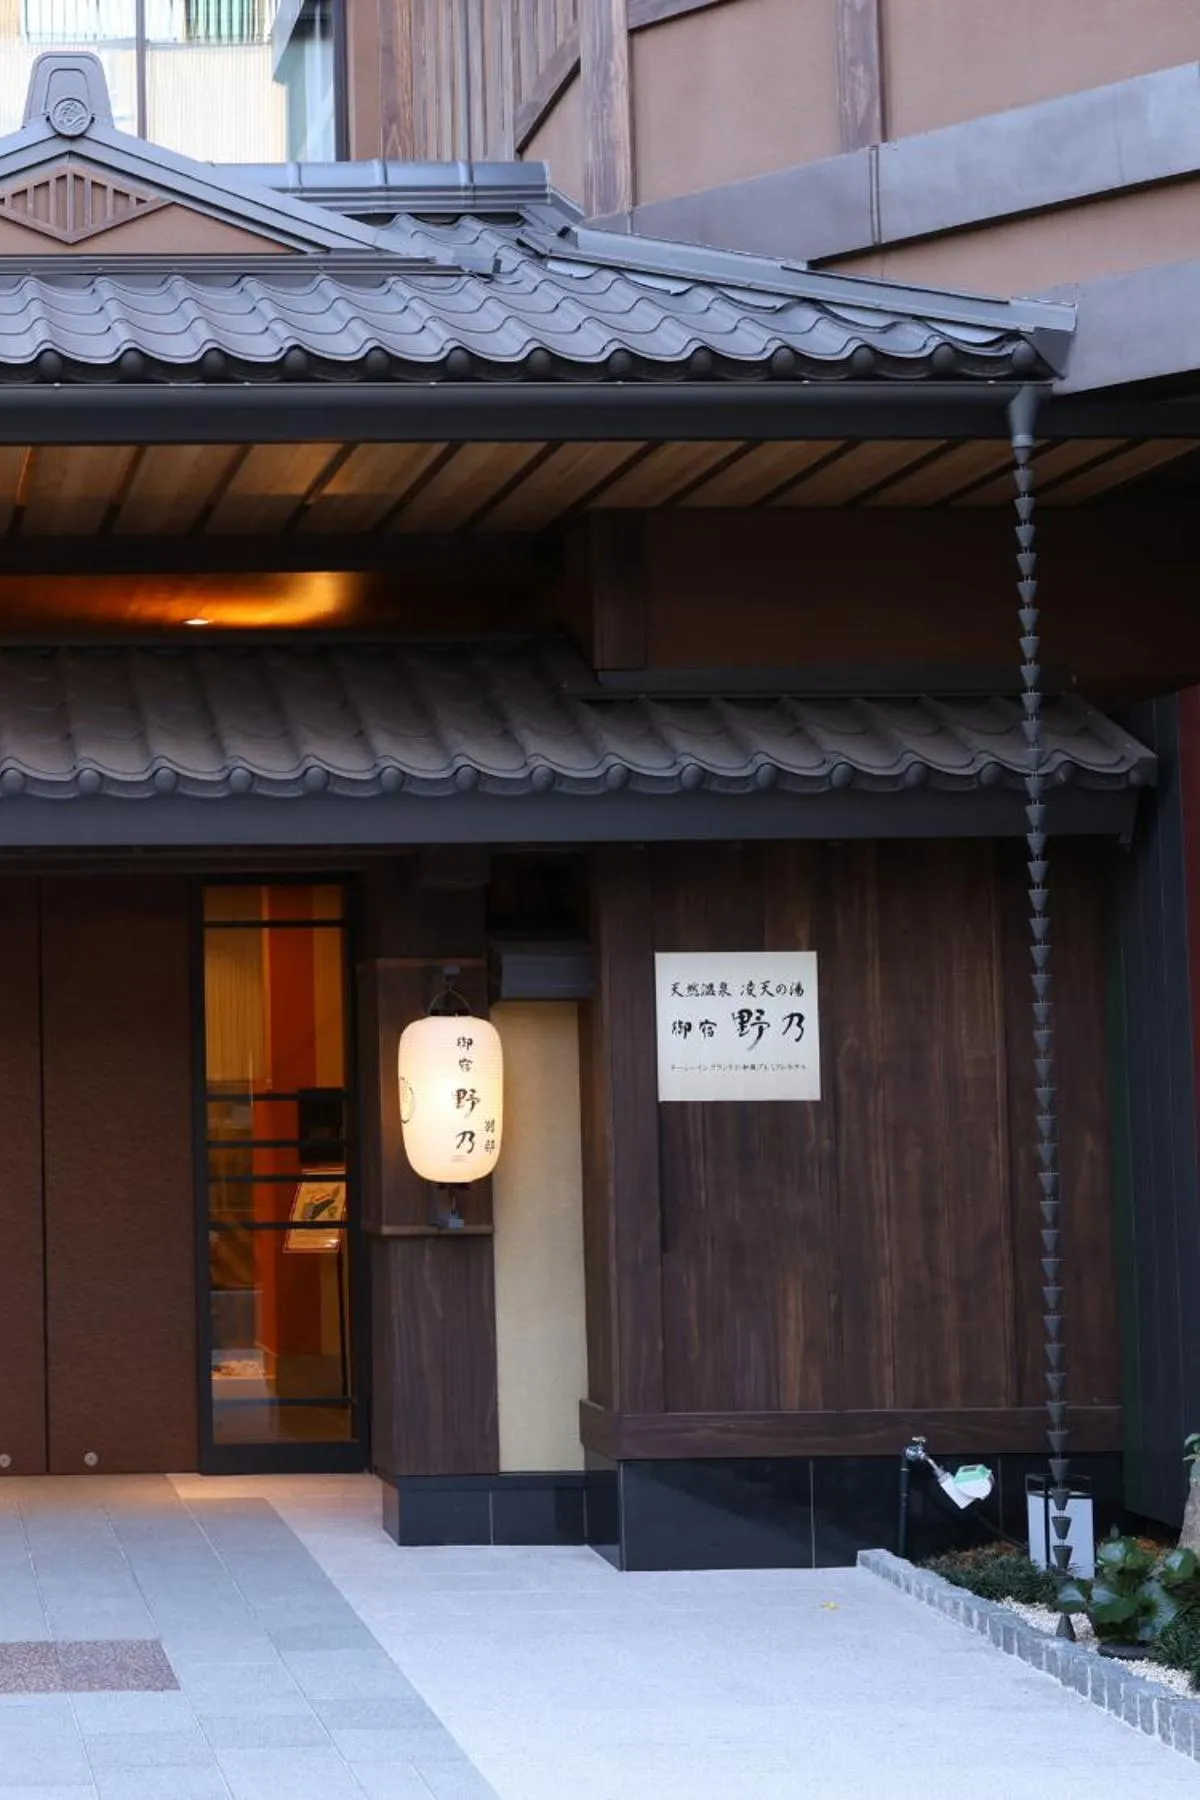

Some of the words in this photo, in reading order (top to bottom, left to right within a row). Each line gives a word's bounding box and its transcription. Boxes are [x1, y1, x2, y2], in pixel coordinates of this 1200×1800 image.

[671, 981, 732, 998] 天然温泉
[671, 1018, 718, 1040] 御宿
[730, 1008, 806, 1051] 野乃
[456, 1036, 473, 1072] 御宿
[452, 1088, 481, 1154] 野乃
